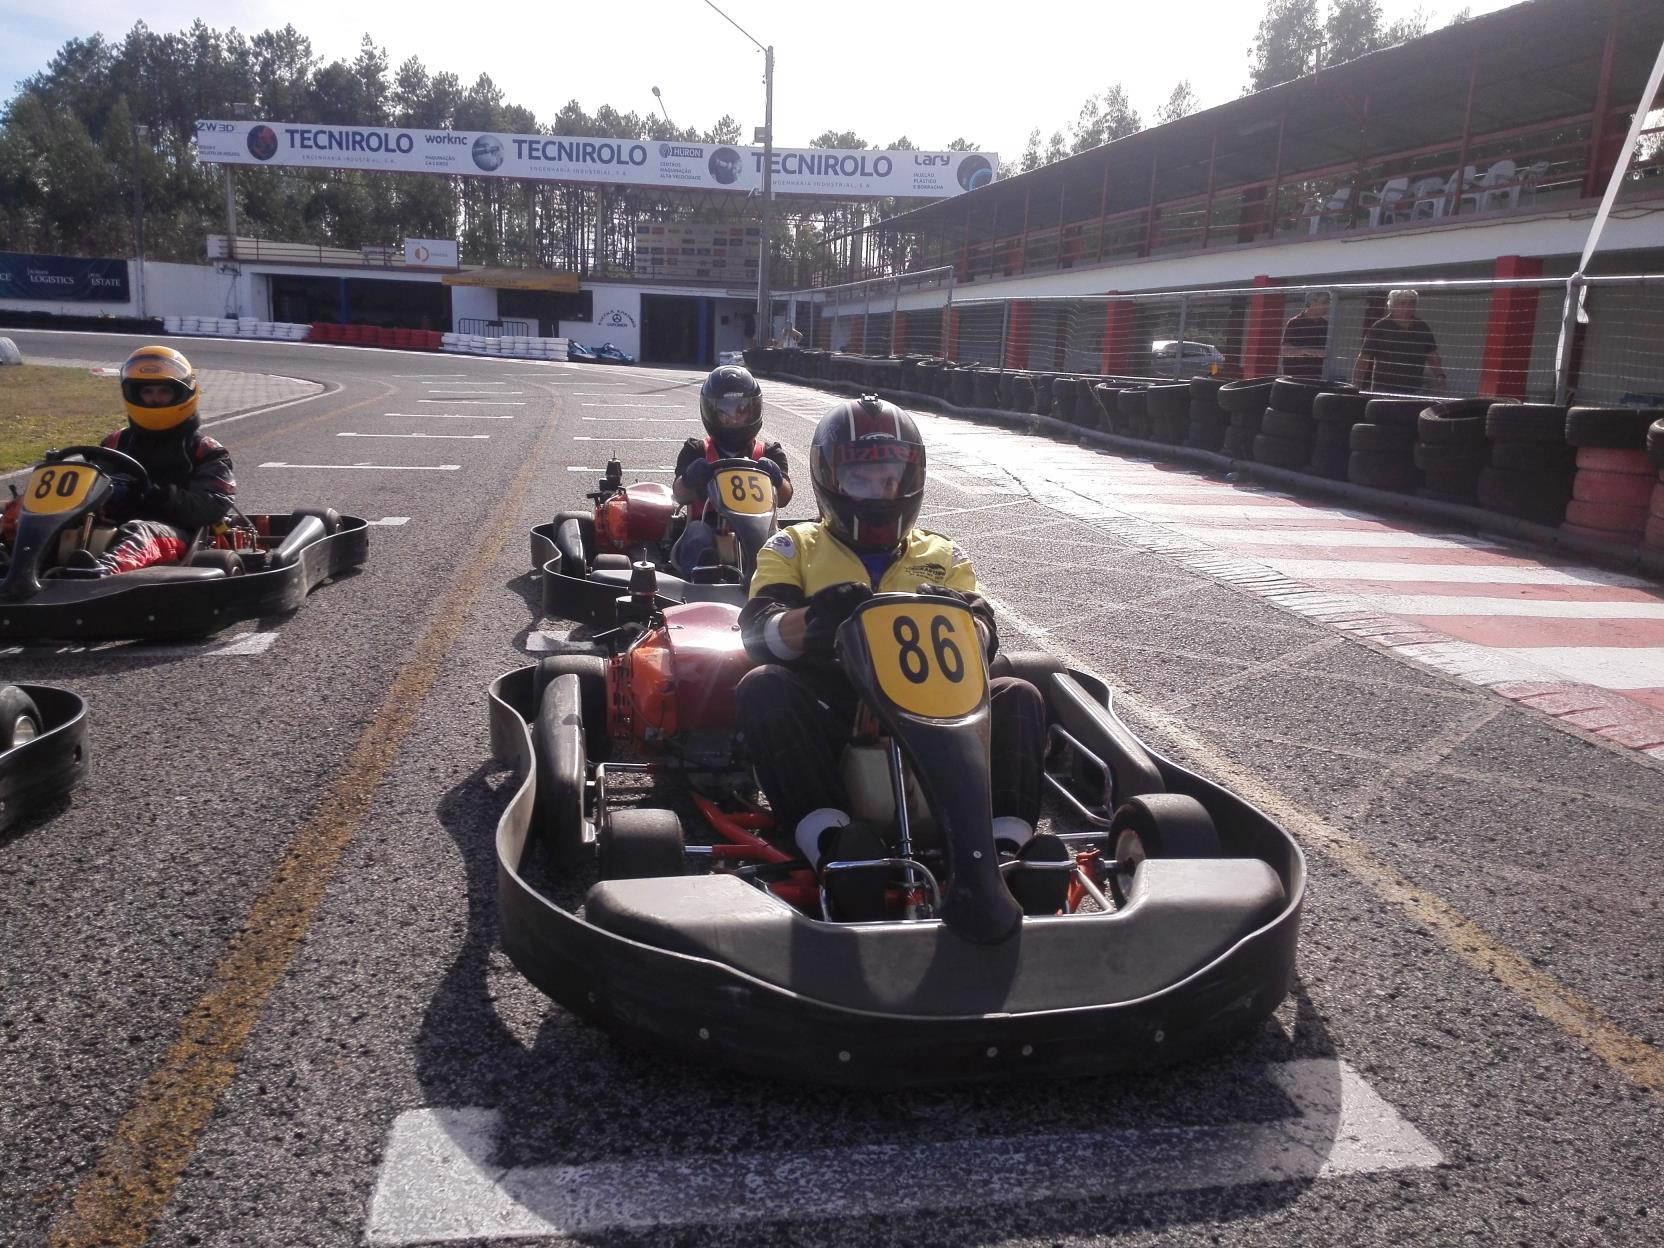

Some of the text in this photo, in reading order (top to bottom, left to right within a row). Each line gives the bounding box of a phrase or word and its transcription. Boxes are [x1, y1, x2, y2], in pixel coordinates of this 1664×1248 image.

[197, 122, 234, 132] ZW3D
[285, 128, 413, 154] TECNIROLO
[424, 132, 467, 146] worknc
[302, 154, 341, 162] ENGENHARIA
[512, 139, 648, 166] TECNIROLO
[674, 147, 701, 158] HURON
[530, 166, 570, 174] ENGENHARIA
[30, 274, 74, 285] LOGISTICS
[91, 278, 121, 287] ESTATE
[34, 470, 80, 499] 80
[730, 475, 764, 503] 85
[893, 614, 965, 685] 86
